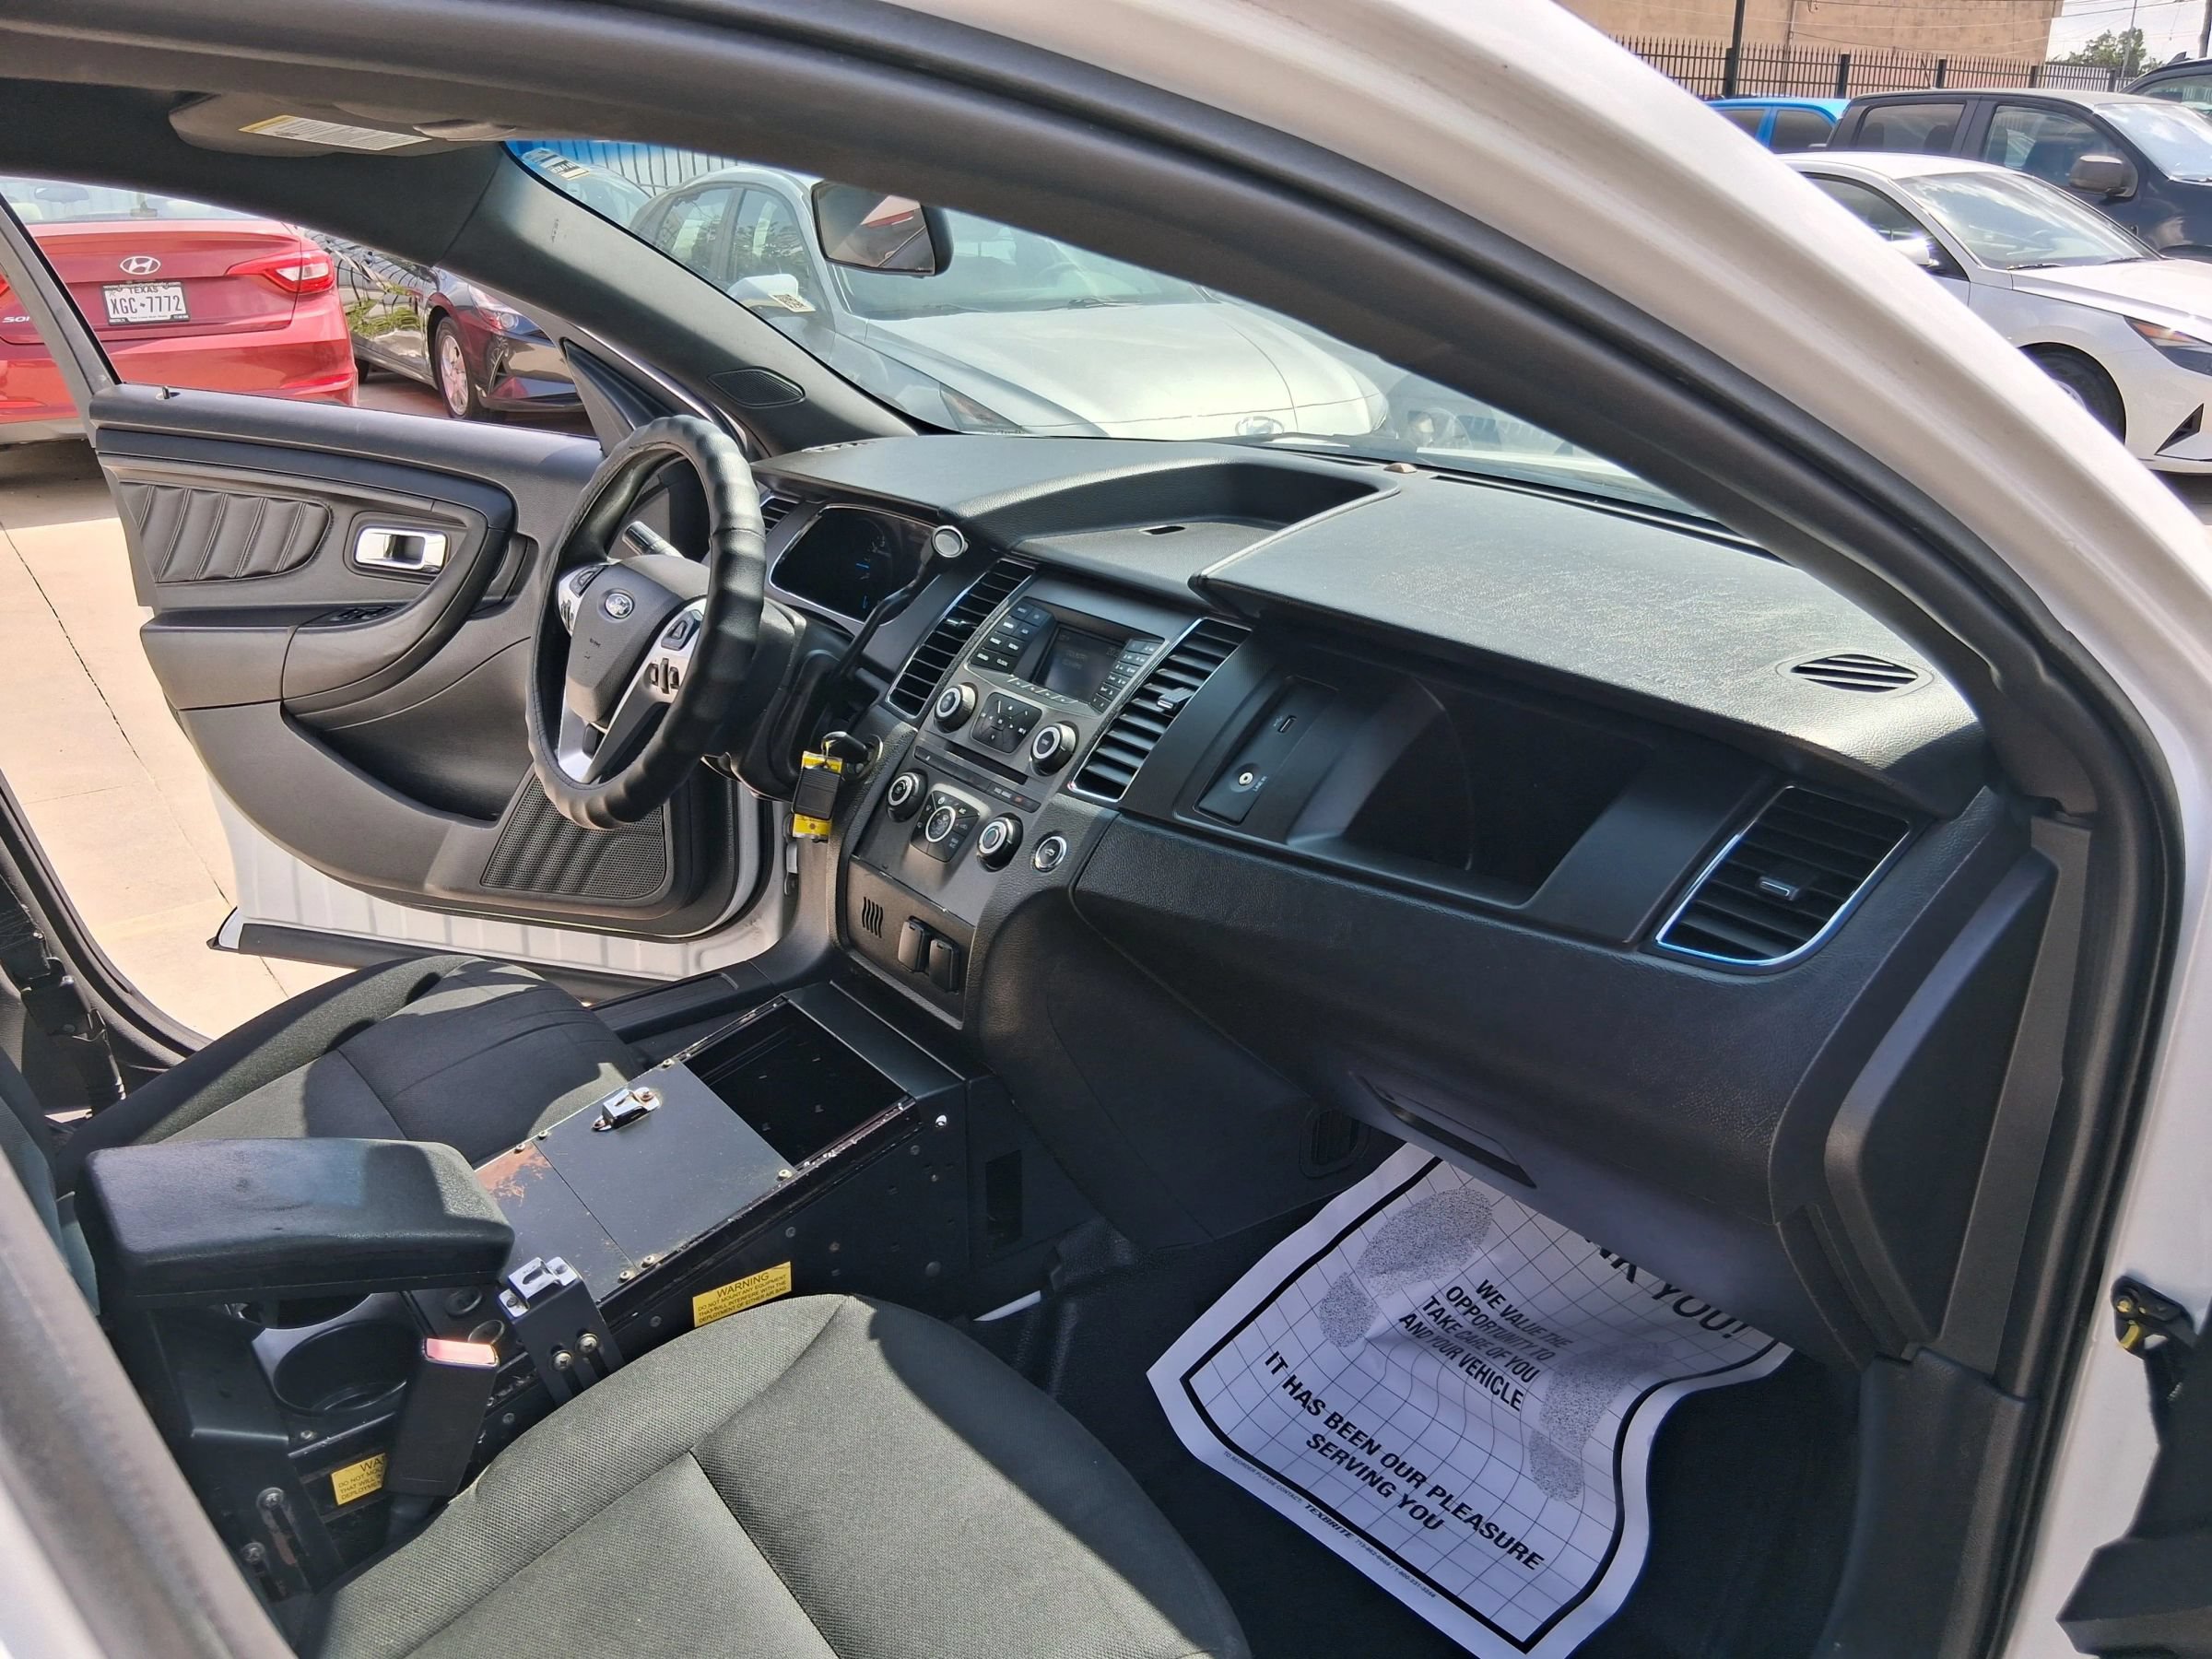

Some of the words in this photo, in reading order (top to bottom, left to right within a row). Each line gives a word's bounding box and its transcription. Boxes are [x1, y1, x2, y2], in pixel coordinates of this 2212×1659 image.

[699, 1306, 735, 1323] DEPLOYMENT
[708, 1299, 720, 1307] NOT
[721, 1290, 741, 1301] MOUNT
[742, 1287, 753, 1295] ANY
[755, 1274, 787, 1289] EQUIPMENT
[717, 1272, 770, 1299] WARNING
[728, 1291, 759, 1306] INTERFERE
[760, 1285, 775, 1293] WITH
[1476, 1279, 1507, 1310] WE
[1499, 1303, 1548, 1337] VALUE
[1544, 1331, 1574, 1348] THE
[1652, 1282, 1750, 1338] YOU!
[1422, 1295, 1464, 1335] TAKE
[1453, 1329, 1495, 1351] CARE
[1485, 1347, 1513, 1360] OF
[1504, 1355, 1541, 1383] YOU
[1445, 1286, 1538, 1356] OPPORTUNITY
[1530, 1347, 1557, 1361] TO
[1398, 1312, 1434, 1339] AND
[1429, 1335, 1465, 1360] YOUR
[1458, 1353, 1524, 1412] VEHICLE
[338, 1480, 348, 1488] DO
[350, 1474, 364, 1483] NOT
[360, 1457, 384, 1472] WA
[1265, 1350, 1289, 1376] IT
[1282, 1374, 1327, 1417] HAS
[1323, 1410, 1382, 1457] BEEN
[1379, 1452, 1430, 1490] OUR
[1425, 1484, 1546, 1571] PLEASURE
[1305, 1432, 1397, 1499] SERVING
[1396, 1492, 1445, 1531] YOU
[1224, 1450, 1232, 1458] TO
[1230, 1455, 1256, 1473] REORDER
[1254, 1470, 1277, 1487] PLEASE
[1304, 1503, 1355, 1540] TEXBRITE
